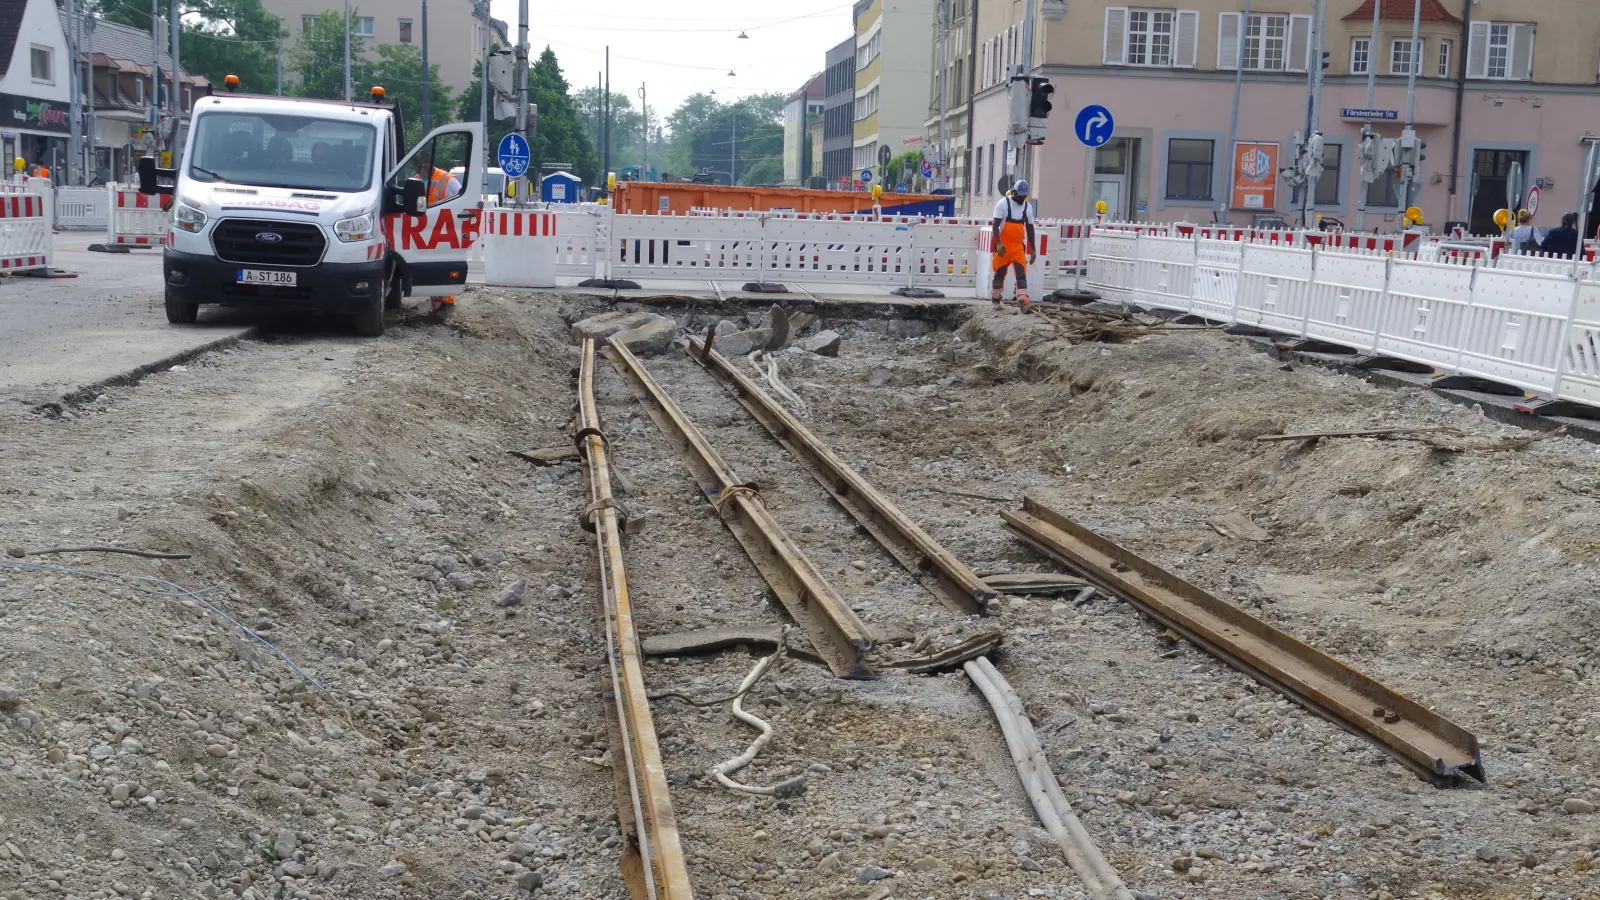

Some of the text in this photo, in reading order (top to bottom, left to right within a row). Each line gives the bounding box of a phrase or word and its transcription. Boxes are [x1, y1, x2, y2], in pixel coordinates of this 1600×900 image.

[1346, 109, 1383, 118] Fürstenrieder
[246, 271, 292, 283] A ST 186
